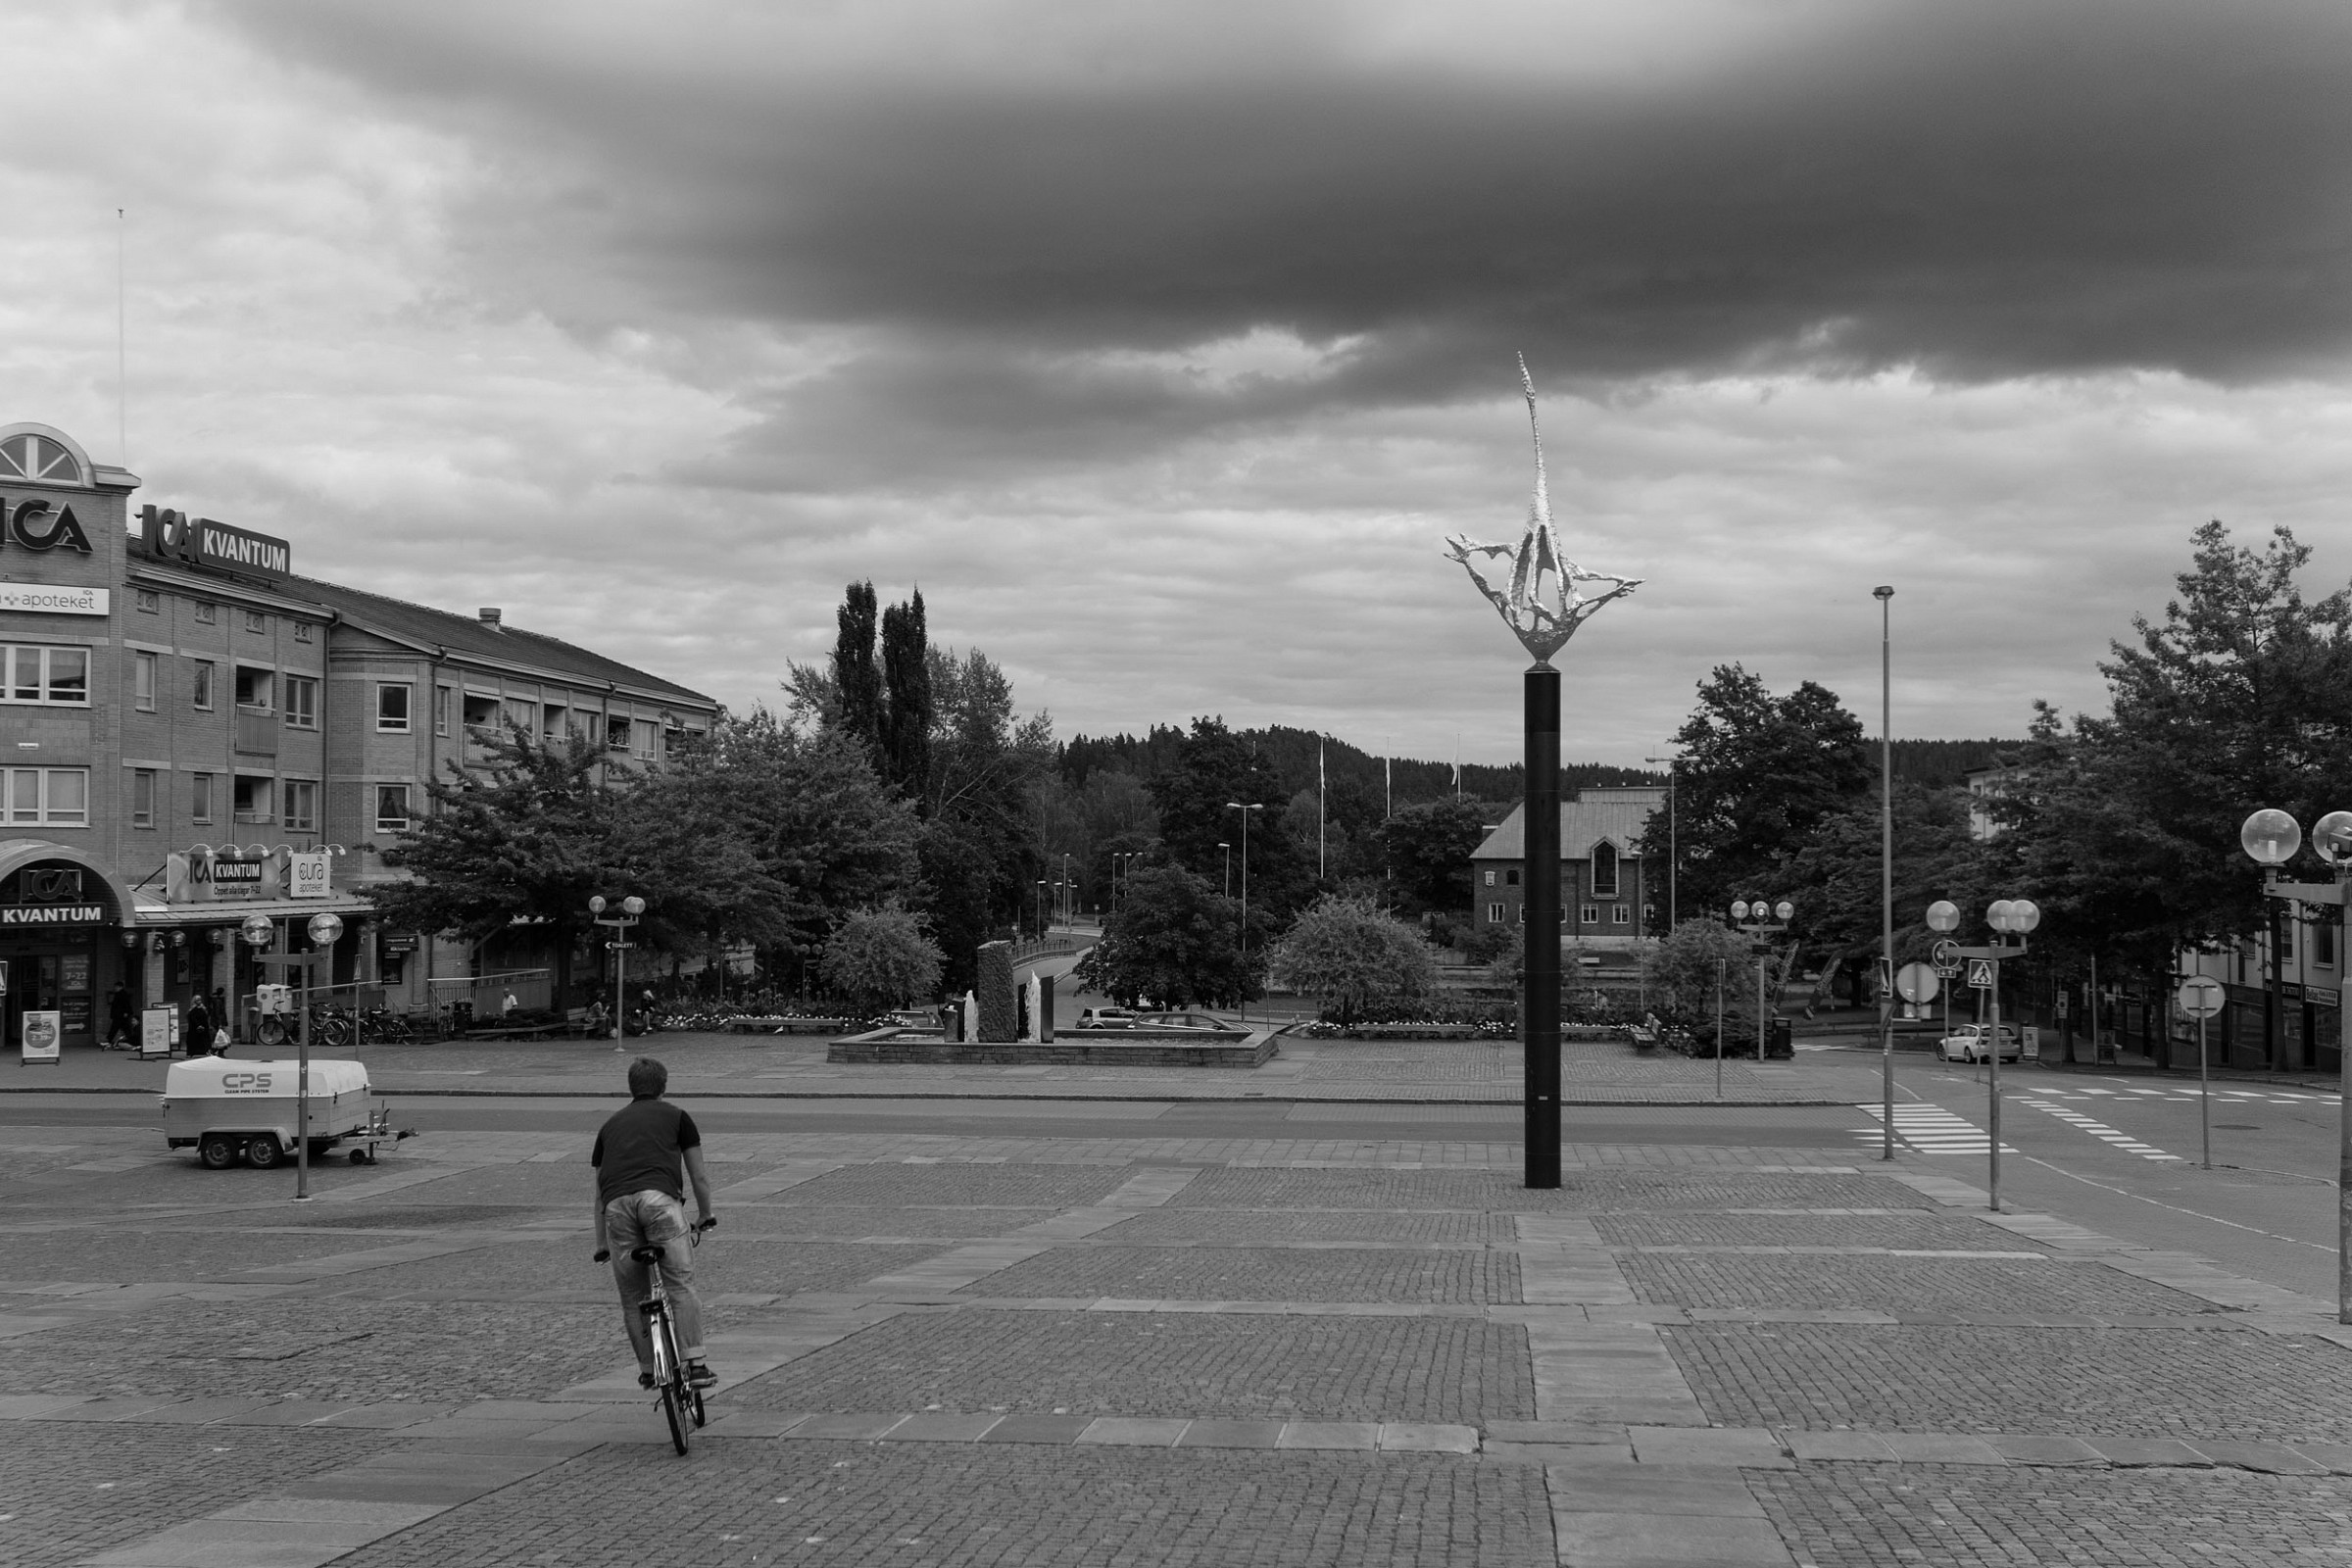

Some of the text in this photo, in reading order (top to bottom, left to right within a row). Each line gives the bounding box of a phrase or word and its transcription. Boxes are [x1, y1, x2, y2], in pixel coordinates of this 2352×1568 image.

[142, 505, 196, 562] ICA
[204, 528, 286, 572] KVANTUM
[23, 593, 95, 609] apoteket
[189, 858, 212, 884] ICA
[216, 863, 260, 878] KVANTUM
[299, 862, 323, 880] cura
[21, 868, 84, 901] ICA
[215, 884, 228, 896] Öppet
[299, 883, 323, 894] apoteket
[3, 906, 101, 923] KVANTUM
[221, 1073, 272, 1089] CPS
